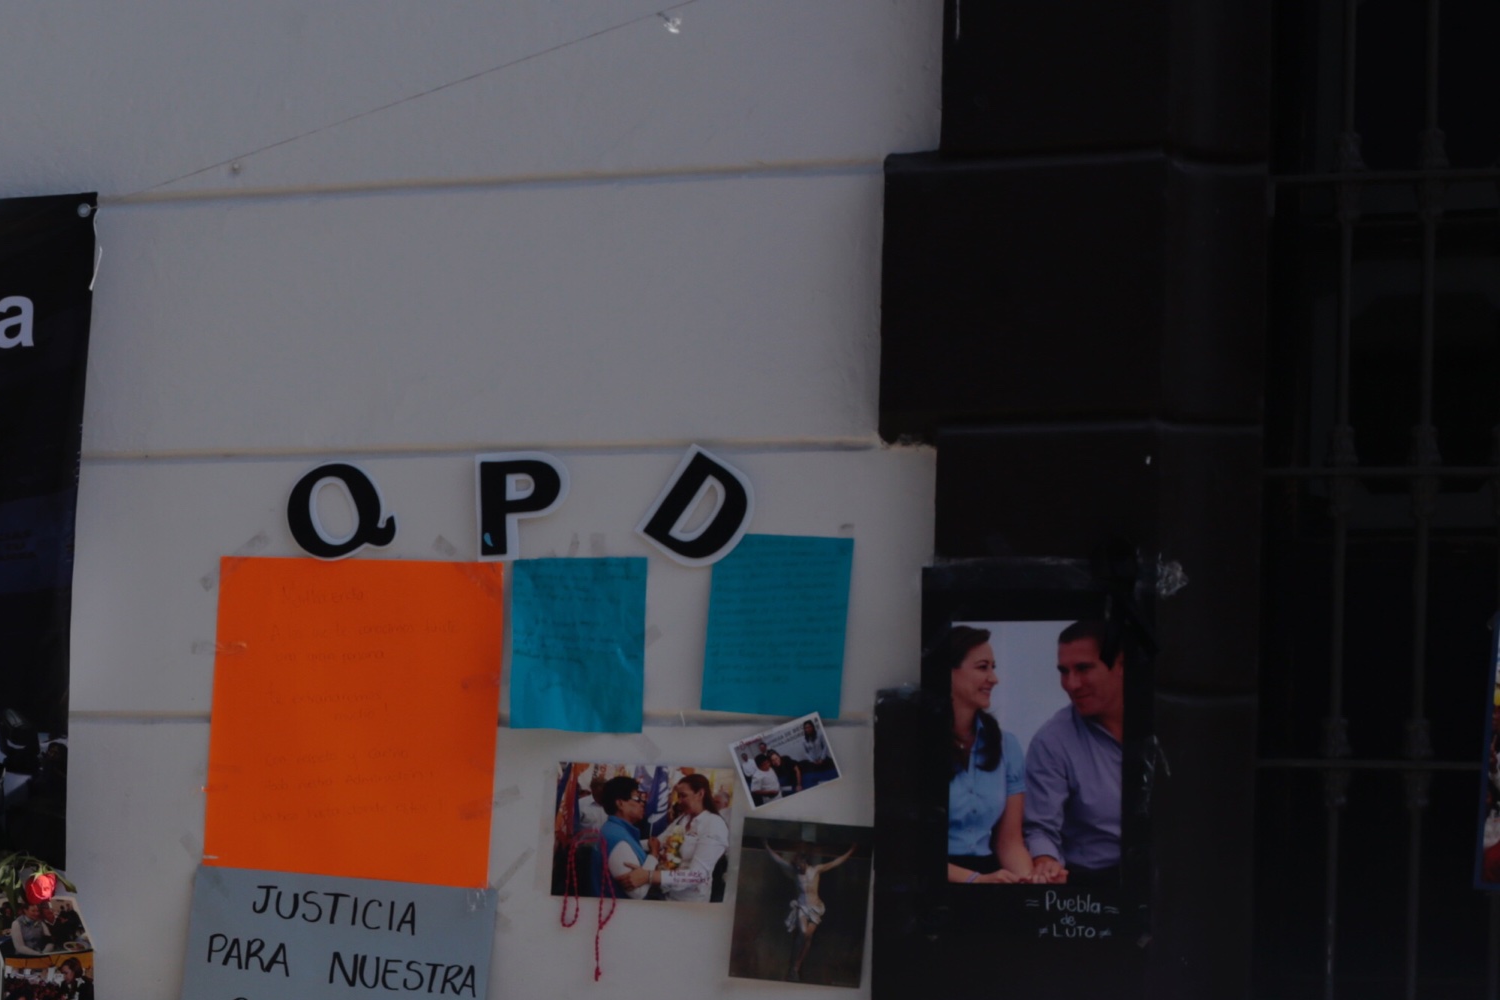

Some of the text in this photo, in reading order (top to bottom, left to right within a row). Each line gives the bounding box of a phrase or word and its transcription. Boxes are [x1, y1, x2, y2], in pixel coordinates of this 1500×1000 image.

[286, 451, 749, 560] Q P D
[252, 885, 416, 936] JUSTICIA
[1045, 889, 1101, 914] Puebla
[1060, 914, 1076, 926] de
[1052, 924, 1097, 938] LUTO
[206, 933, 477, 998] PARA NUESTRA
